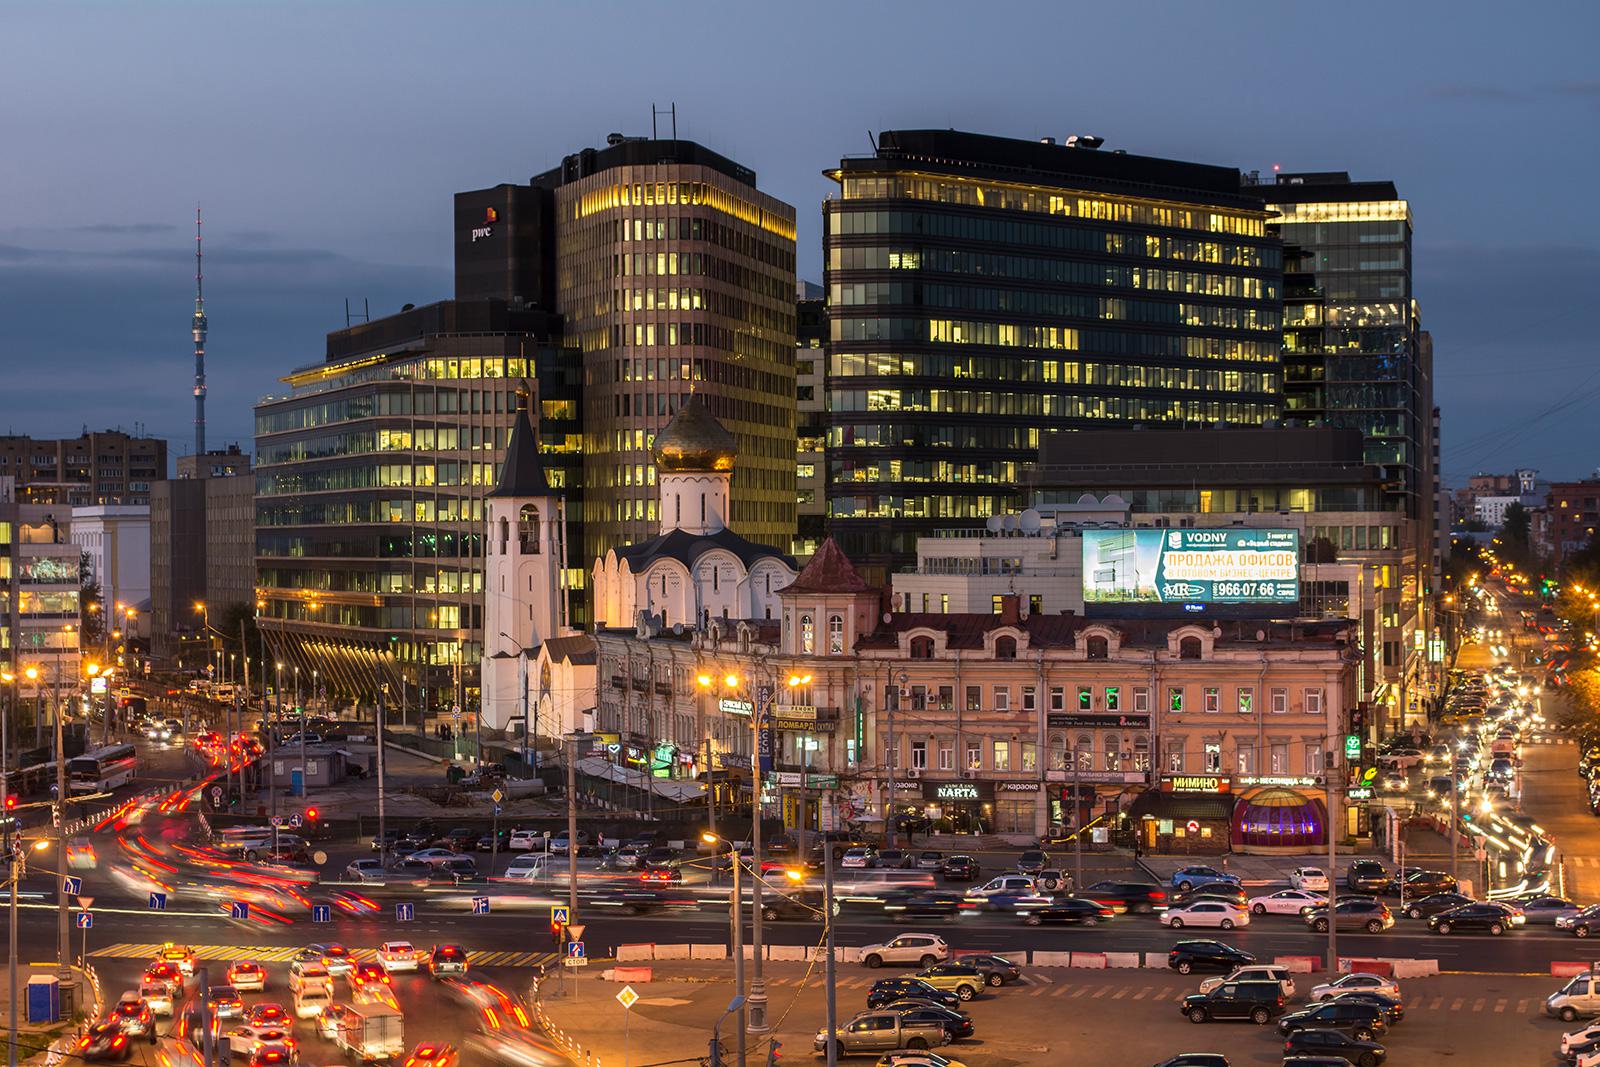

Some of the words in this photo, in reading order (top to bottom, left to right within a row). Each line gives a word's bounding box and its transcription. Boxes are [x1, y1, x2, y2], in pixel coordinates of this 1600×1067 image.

[472, 227, 492, 242] pwc
[1186, 533, 1227, 543] VODNY
[1267, 532, 1271, 540] 5
[1168, 553, 1234, 567] ПРОДАЖА
[1239, 553, 1293, 567] ОФИСОВ
[1168, 569, 1173, 578] В
[1177, 569, 1216, 578] ГОТОВОМ
[778, 720, 815, 731] ЛОМБАРД
[1007, 783, 1039, 791] караоке
[1173, 777, 1218, 788] МИМИНО
[937, 788, 978, 798] NARTA
[1349, 788, 1371, 799] КАФЕ
